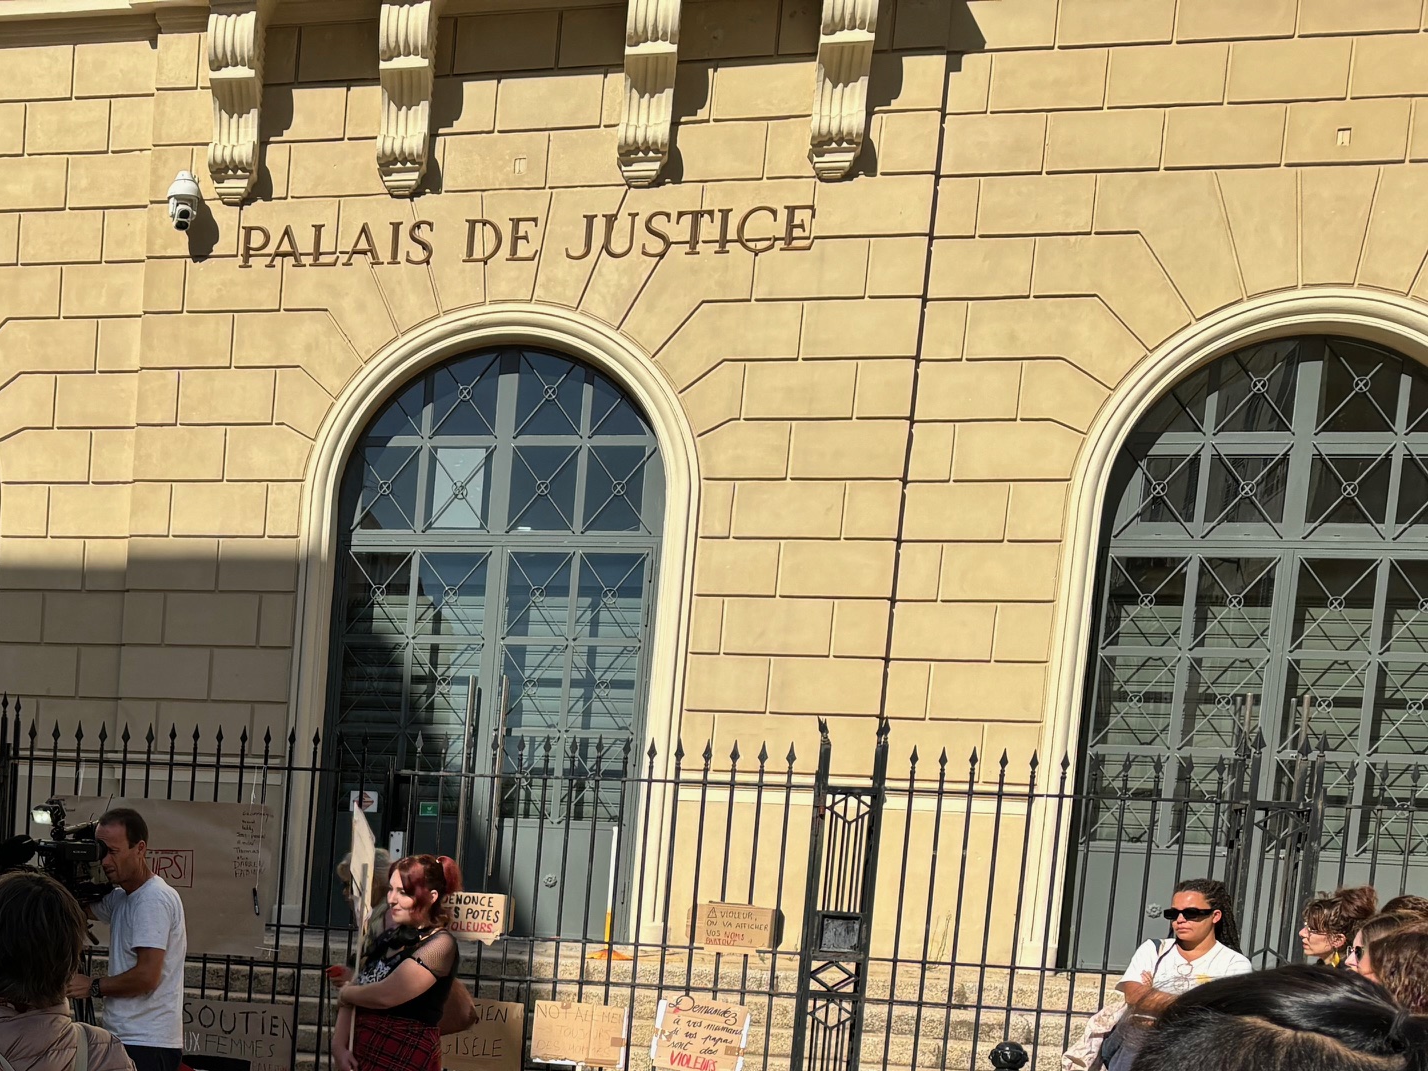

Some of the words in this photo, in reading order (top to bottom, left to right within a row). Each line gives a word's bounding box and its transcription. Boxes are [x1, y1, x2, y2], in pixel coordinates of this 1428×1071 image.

[239, 220, 434, 268] PALAIS
[462, 216, 539, 262] DE
[566, 204, 816, 260] JUSTICE
[466, 908, 500, 924] POTES
[451, 922, 493, 933] OLEURS
[735, 923, 769, 932] AFFICHER
[724, 931, 745, 941] NOMS
[669, 995, 737, 1026] Demandez
[686, 1020, 702, 1028] vos
[184, 1031, 201, 1052] UX
[204, 1033, 275, 1058] FEMMES
[536, 1040, 560, 1051] DES
[685, 1031, 698, 1039] vos
[702, 1034, 734, 1048] papas
[668, 1041, 693, 1051] sont
[699, 1047, 719, 1055] des
